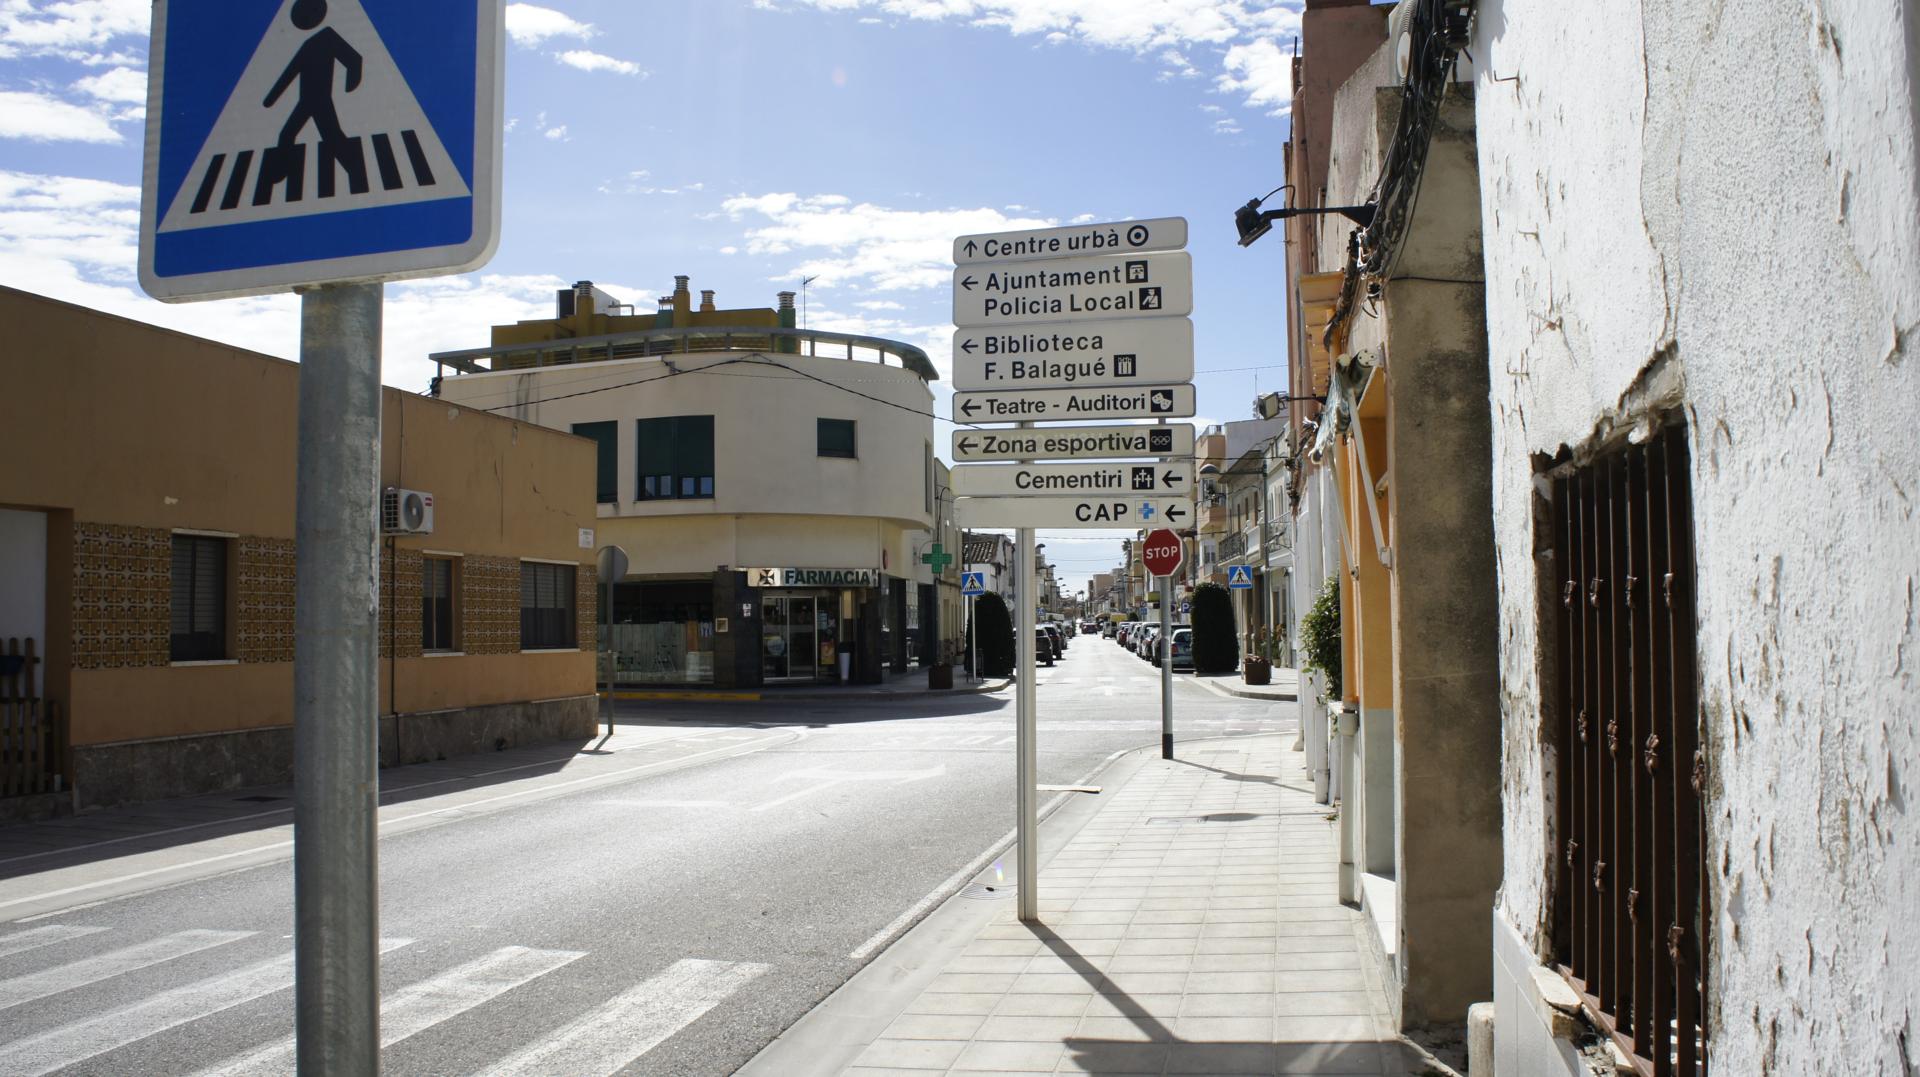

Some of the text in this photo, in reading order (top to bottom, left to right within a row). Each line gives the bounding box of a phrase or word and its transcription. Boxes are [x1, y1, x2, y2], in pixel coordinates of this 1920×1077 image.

[984, 228, 1119, 258] Centre urbà
[985, 265, 1121, 292] Ajuntament
[984, 290, 1134, 317] Policia Local
[985, 334, 1103, 355] Biblioteca
[984, 358, 1106, 381] F. Balagué
[986, 398, 1046, 415] Teatre
[1066, 394, 1145, 412] Auditori
[983, 432, 1147, 456] Zona esportiva
[1015, 469, 1122, 490] Cementiri
[1075, 503, 1128, 522] CAP
[1146, 546, 1178, 559] STOP
[785, 569, 871, 585] FARMACIA
